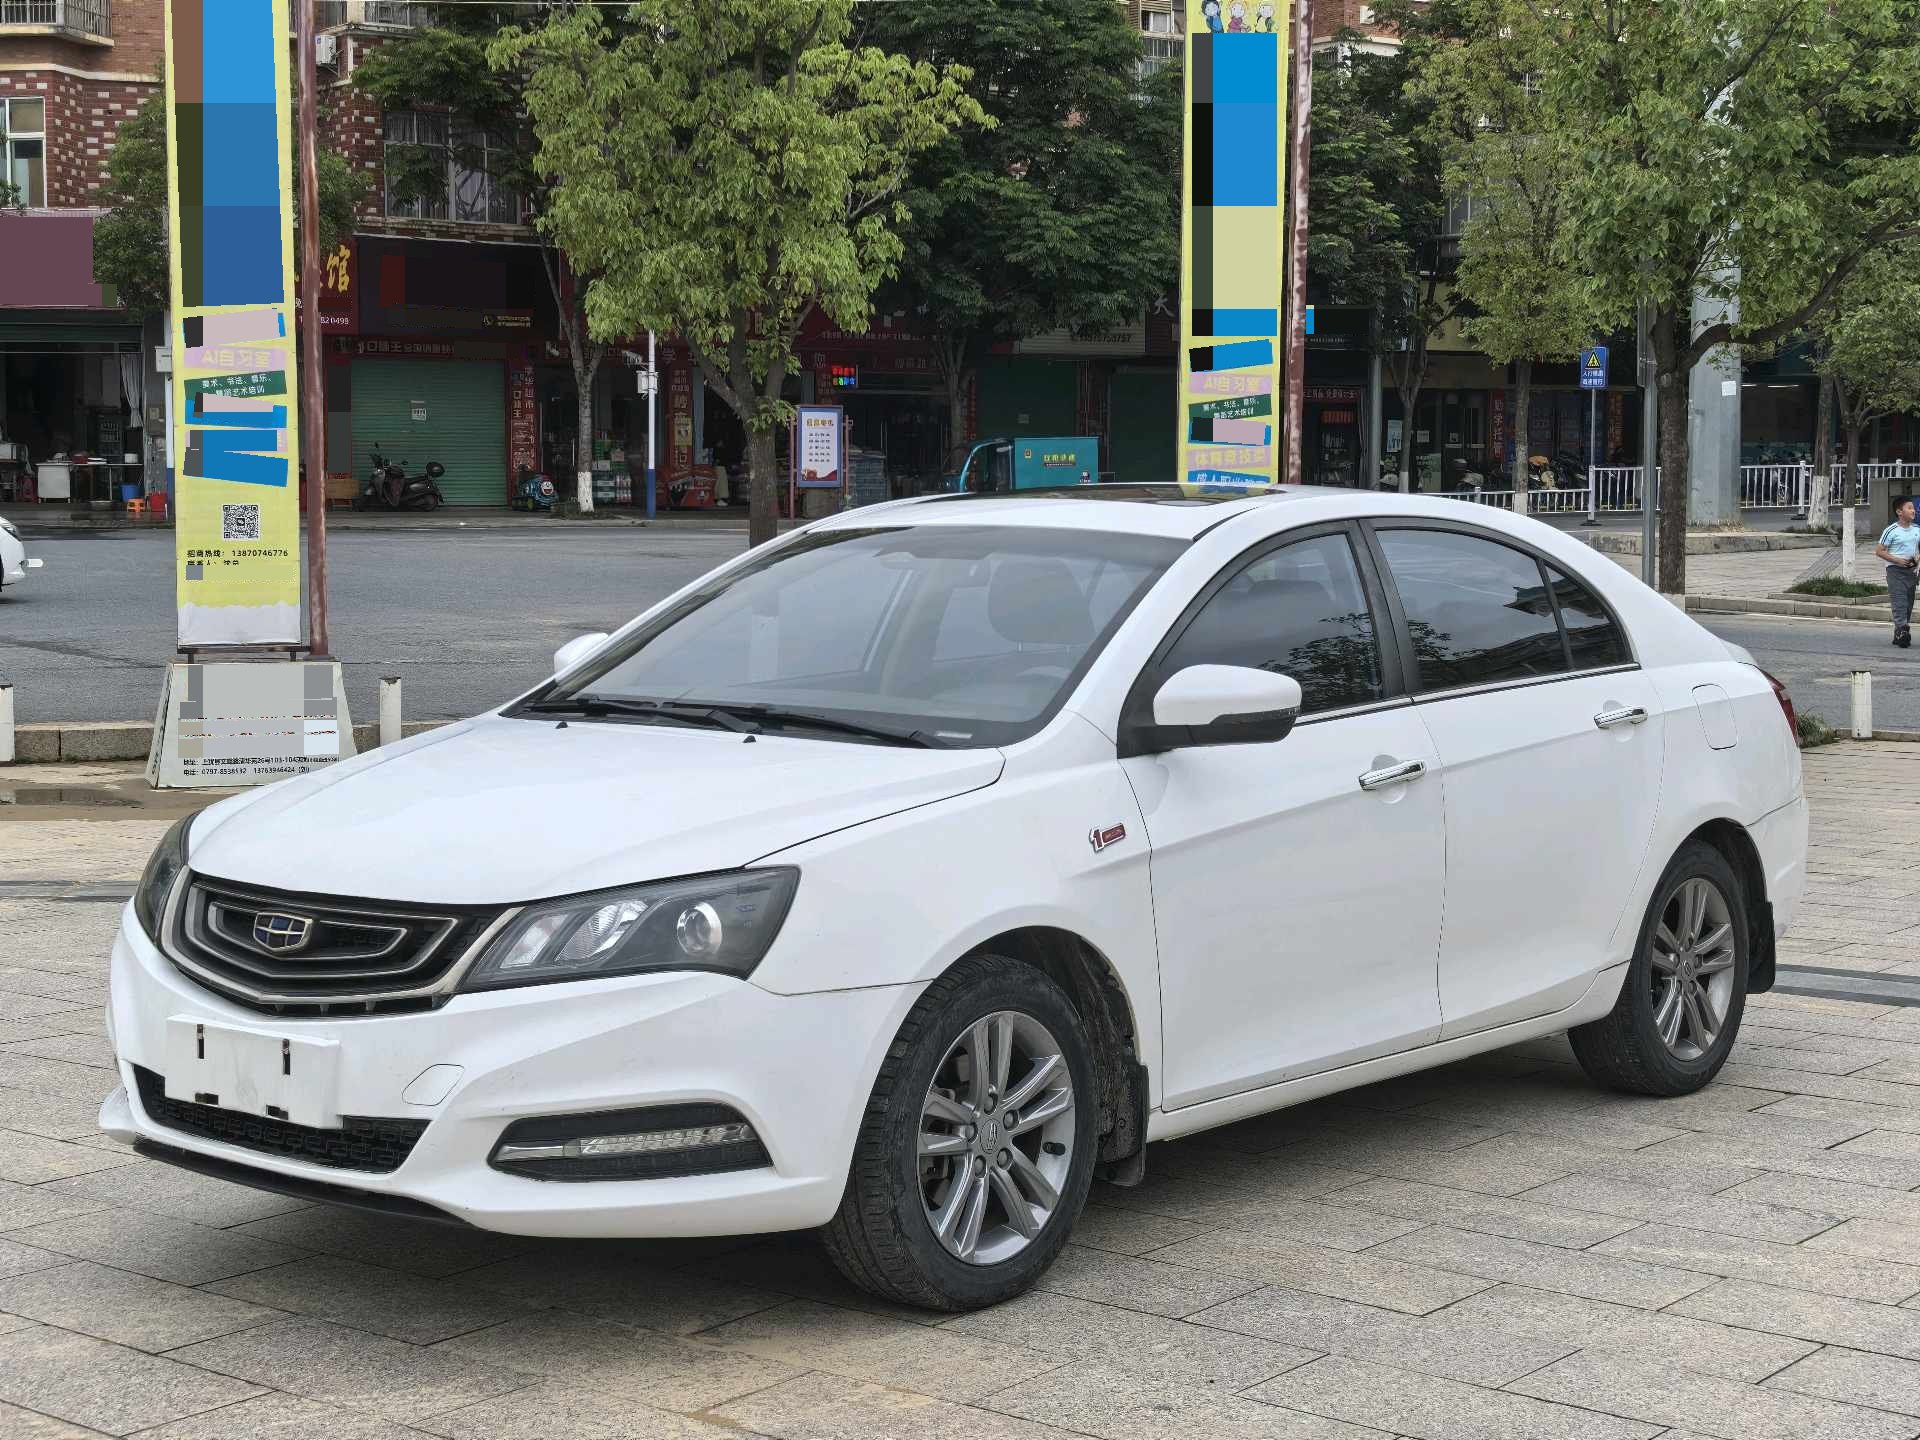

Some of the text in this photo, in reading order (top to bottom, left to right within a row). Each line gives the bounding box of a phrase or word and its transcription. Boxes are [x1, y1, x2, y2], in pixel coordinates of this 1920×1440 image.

[201, 349, 272, 369] AI自习室
[231, 549, 288, 557] 13870746776
